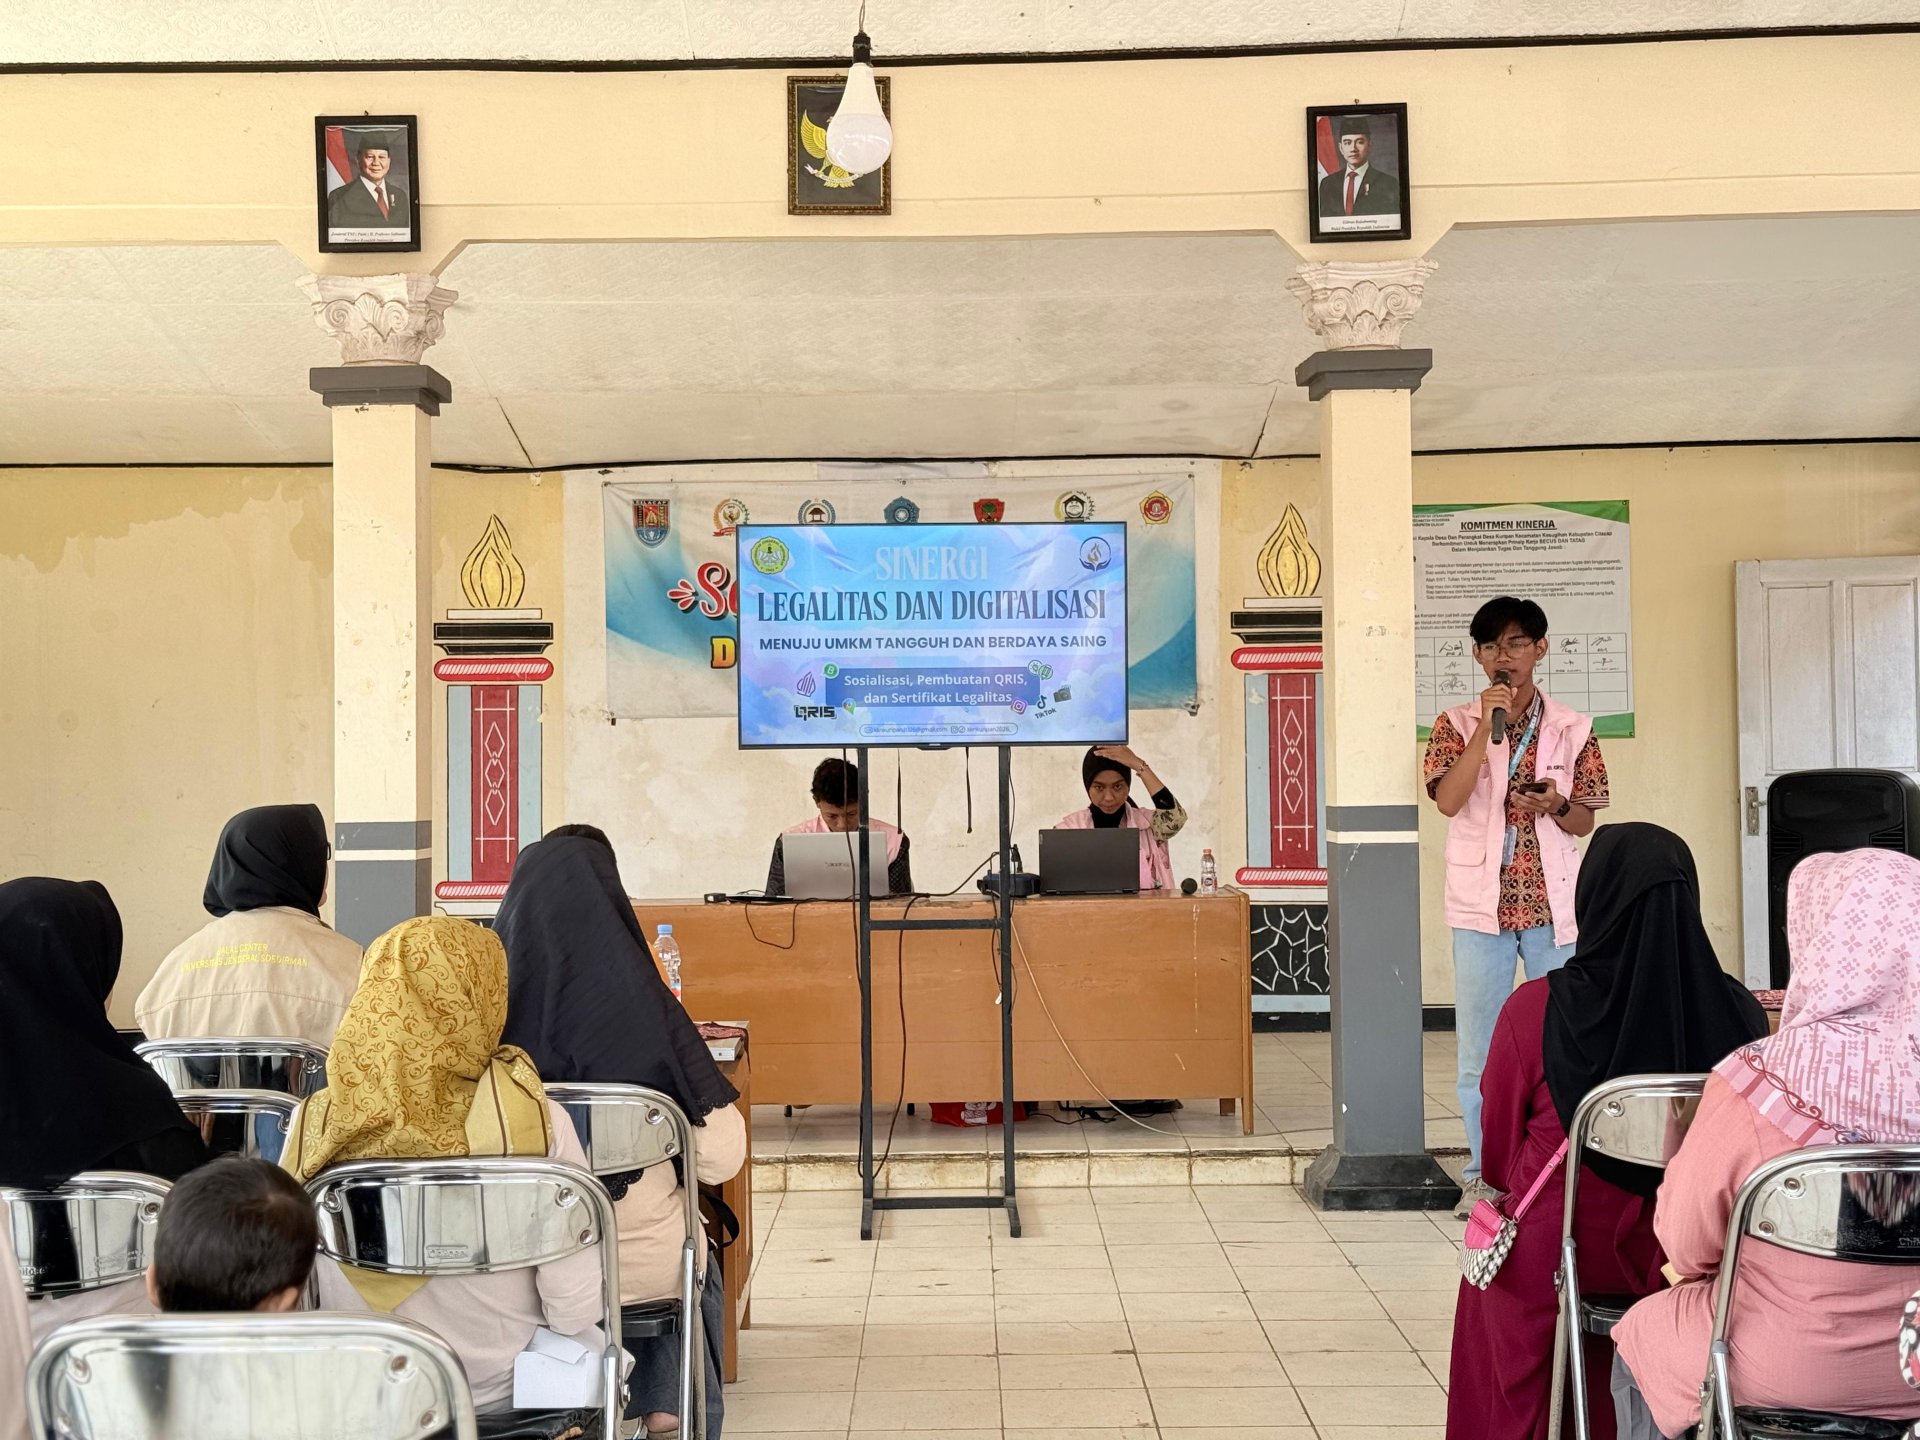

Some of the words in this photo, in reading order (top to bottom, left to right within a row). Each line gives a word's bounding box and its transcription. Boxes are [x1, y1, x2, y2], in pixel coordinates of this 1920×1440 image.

[1460, 521, 1513, 530] KOMITMEN
[1516, 520, 1555, 529] KINERJA
[875, 545, 988, 581] SINERGI
[757, 591, 888, 622] LEGALITAS
[896, 591, 942, 621] DAN
[951, 589, 1106, 620] DIGITALISASI
[759, 638, 821, 650] MENUJU
[825, 637, 872, 650] UMKM
[875, 637, 949, 649] TANGGUH
[952, 637, 985, 648] DAN
[988, 636, 1057, 648] BERDAYA
[1060, 635, 1107, 647] SAING
[844, 675, 913, 687] Sosialisasi,
[917, 674, 990, 686] Pembuatan
[994, 674, 1027, 686] QRIS,
[864, 693, 888, 704] dan
[891, 692, 951, 704] Sertifikat
[955, 692, 1012, 705] Legalitas
[795, 705, 836, 721] QRIS
[1034, 707, 1057, 719] TikTok
[240, 943, 269, 953] CENTER
[261, 953, 309, 967] SOEDIRMAN
